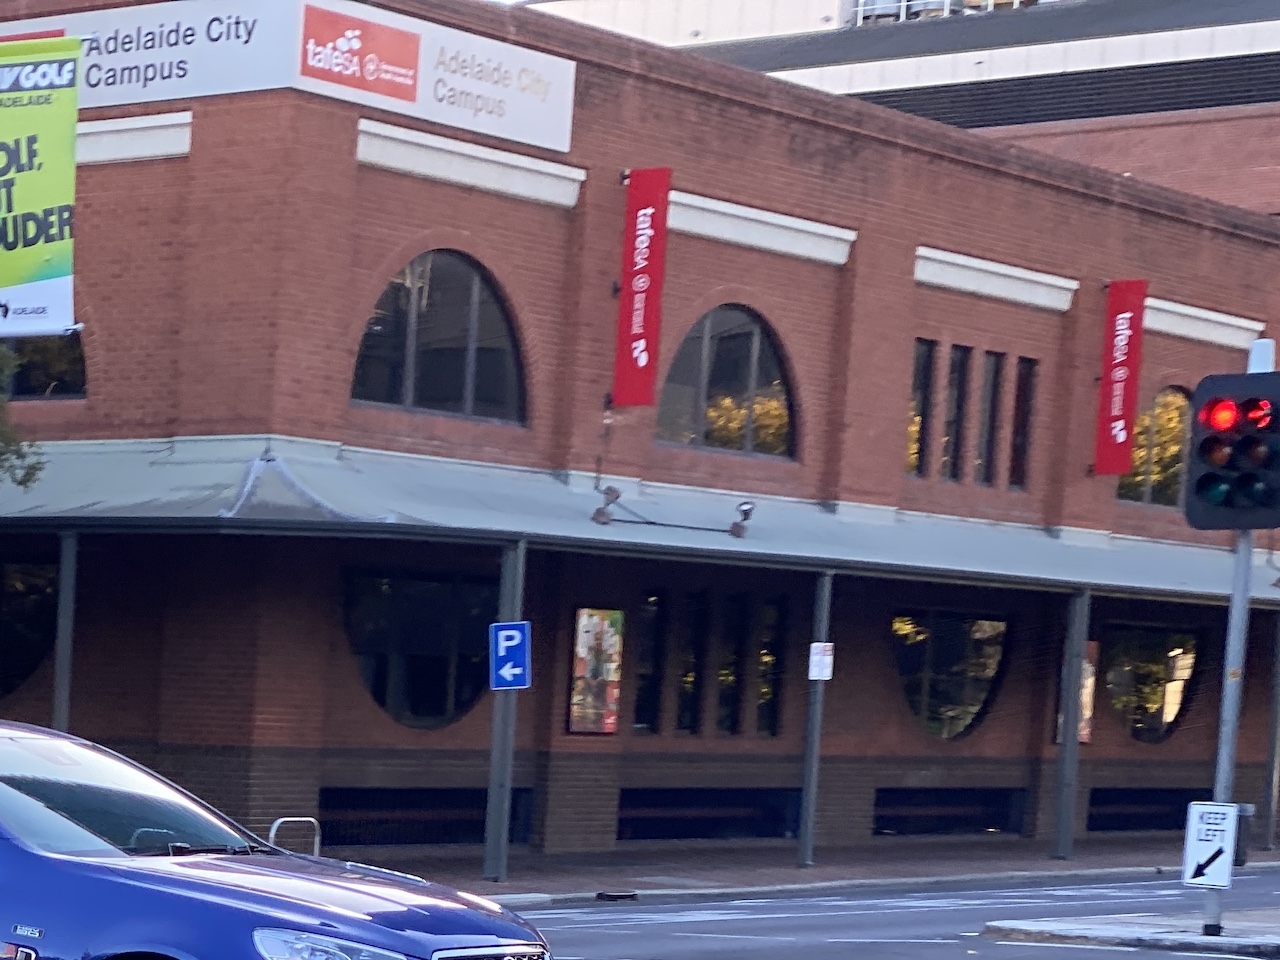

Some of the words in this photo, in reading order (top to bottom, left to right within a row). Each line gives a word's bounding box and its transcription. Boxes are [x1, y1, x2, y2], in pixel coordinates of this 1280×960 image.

[84, 21, 197, 57] Adelaide
[206, 16, 257, 45] City
[19, 62, 75, 88] GOLF
[85, 57, 189, 89] Campus
[433, 46, 512, 88] Adelaide
[517, 67, 552, 102] City
[433, 77, 507, 118] Campus
[498, 630, 522, 656] P
[1199, 811, 1227, 825] KEEP
[1197, 828, 1226, 843] LEFT
